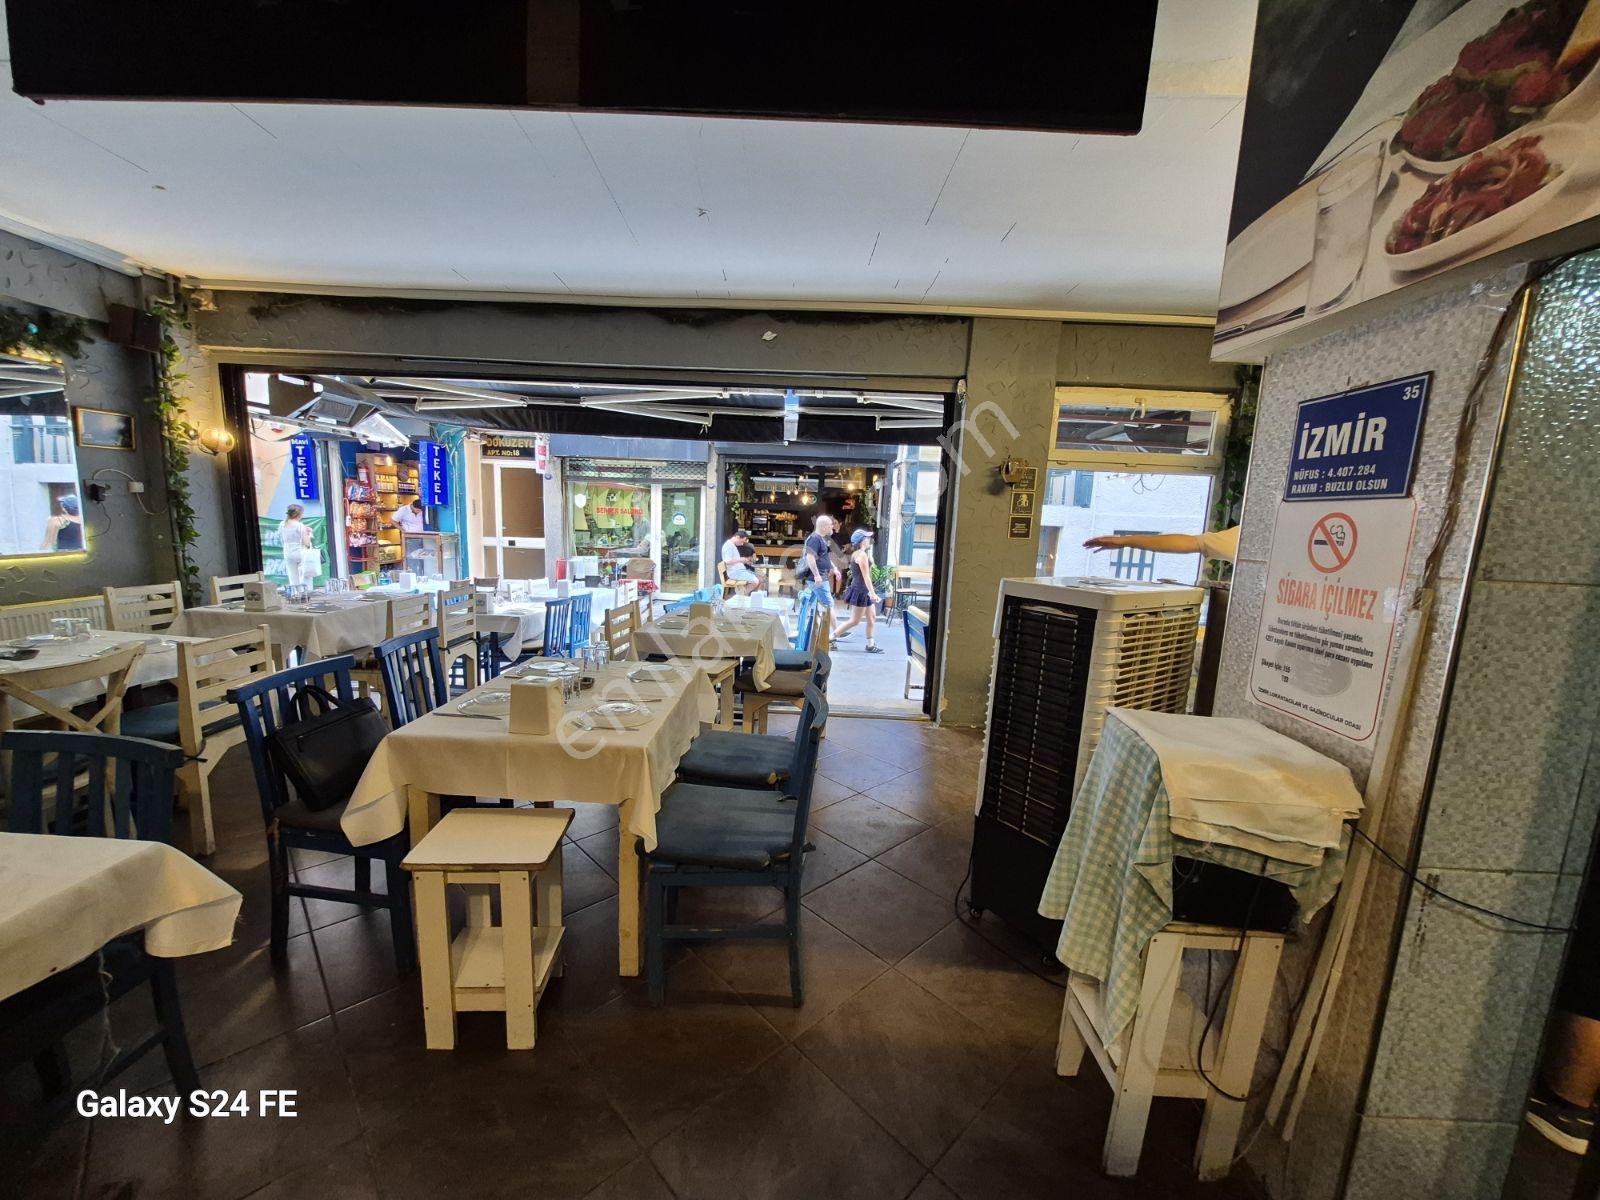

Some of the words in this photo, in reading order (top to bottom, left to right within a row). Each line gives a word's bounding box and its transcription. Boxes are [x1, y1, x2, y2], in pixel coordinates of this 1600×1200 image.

[1403, 385, 1420, 400] 35
[1298, 412, 1387, 460] İZMİR
[295, 446, 310, 498] TEKEL
[432, 446, 442, 505] TEKEL
[1291, 483, 1317, 494] RAKIM
[1325, 481, 1353, 492] BUZLU
[1355, 478, 1388, 490] OLSUN
[1293, 467, 1320, 480] NÜFUS
[1327, 464, 1376, 478] 4.407.284
[1276, 572, 1317, 610] SİGARA
[1320, 575, 1378, 621] İÇİLMEZ
